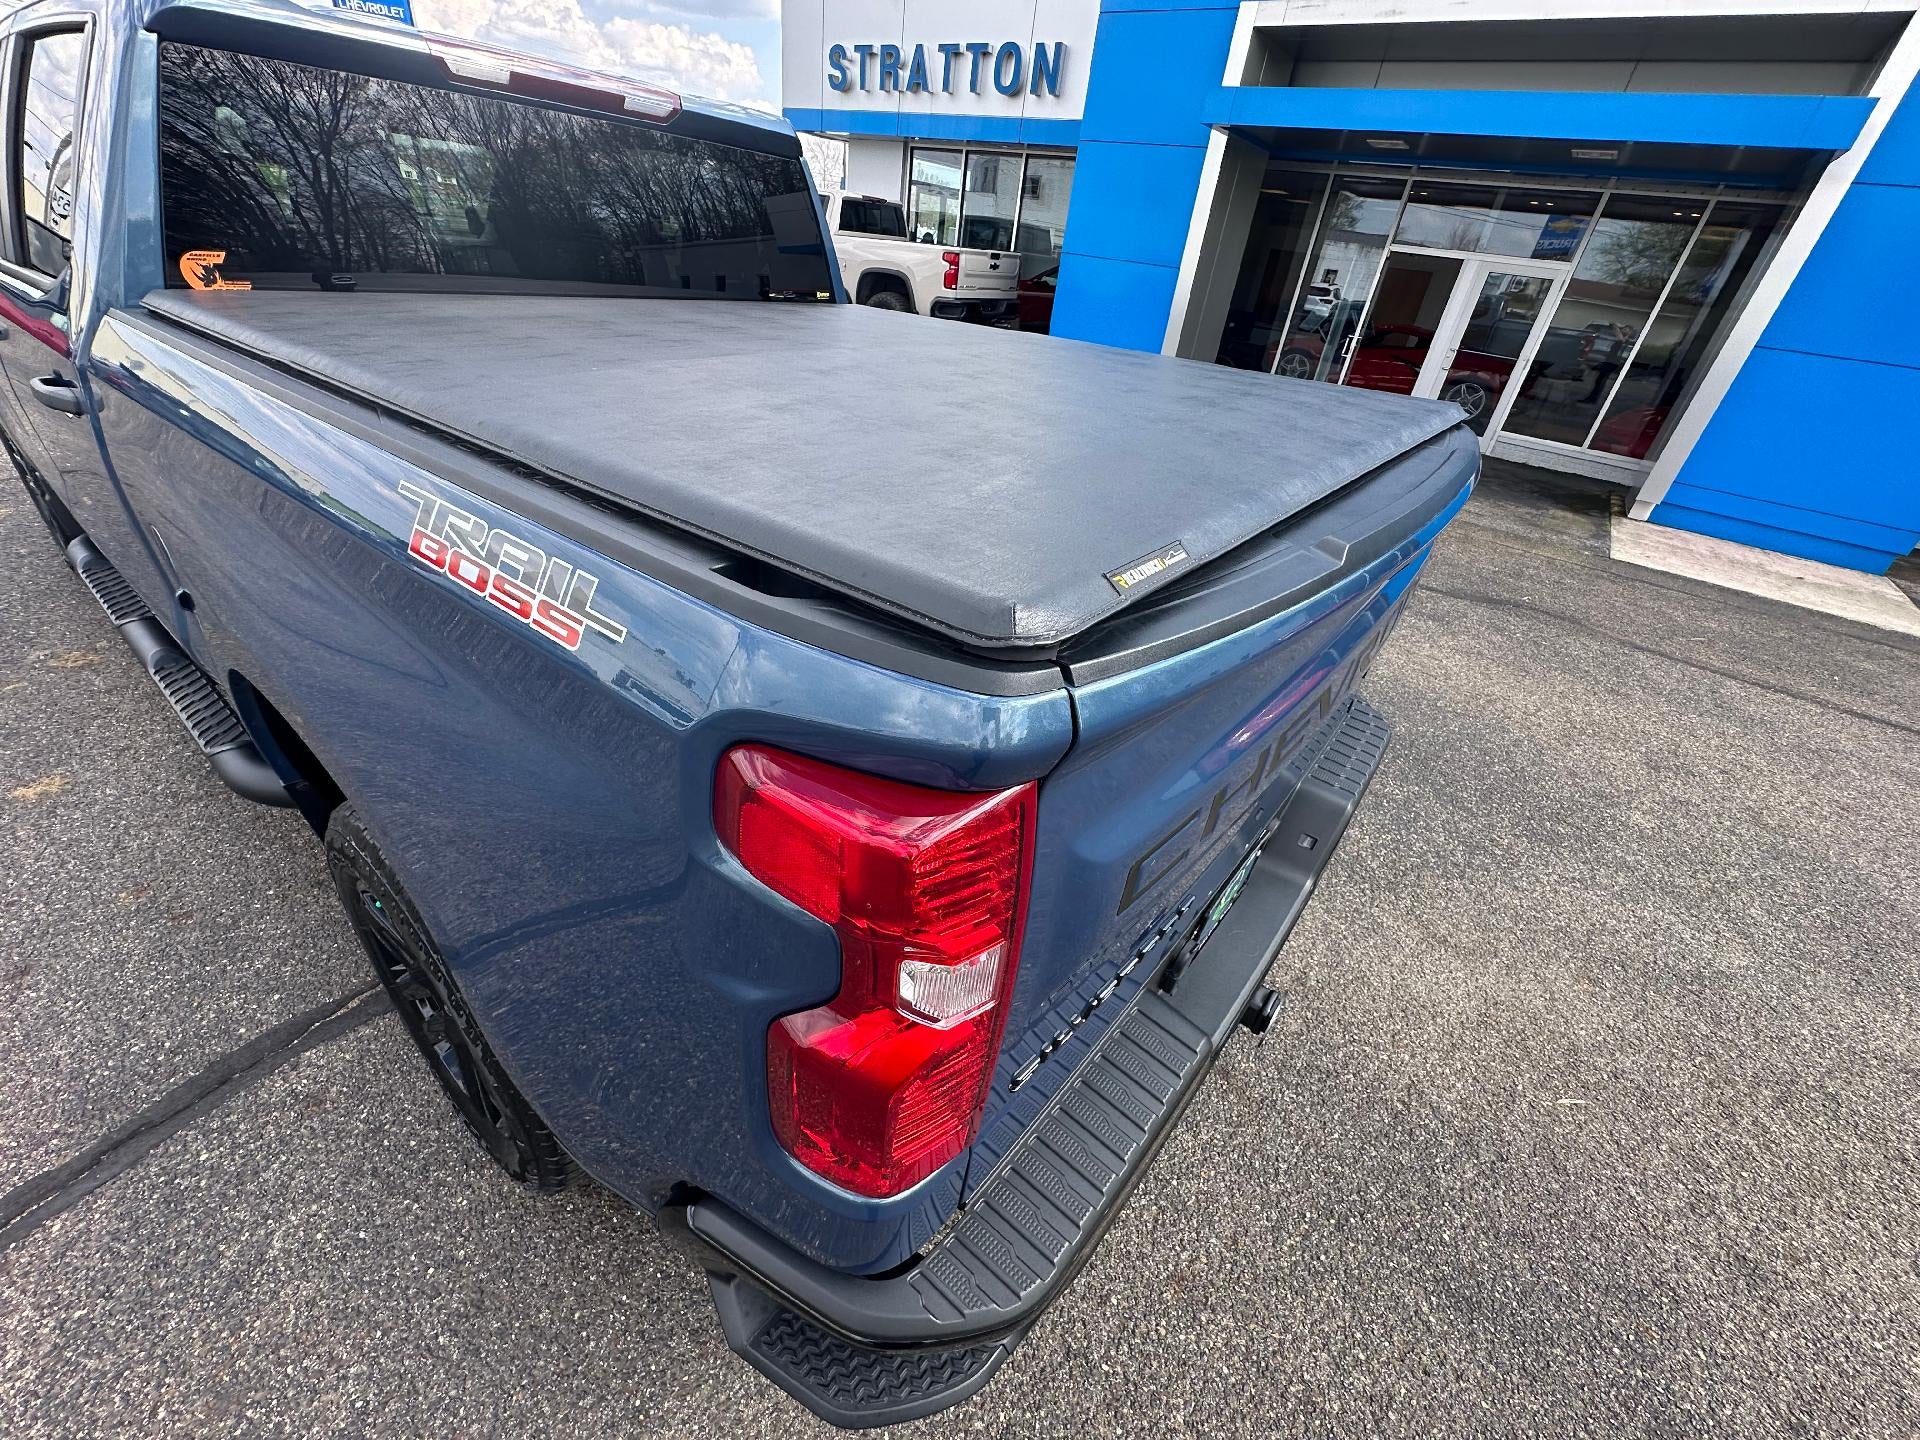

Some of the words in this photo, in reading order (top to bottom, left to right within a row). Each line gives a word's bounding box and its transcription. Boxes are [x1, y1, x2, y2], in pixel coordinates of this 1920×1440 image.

[338, 0, 405, 19] CHEVROLET
[827, 41, 1067, 97] STRATTON
[398, 480, 628, 644] TRAIL
[407, 526, 586, 652] BOSS
